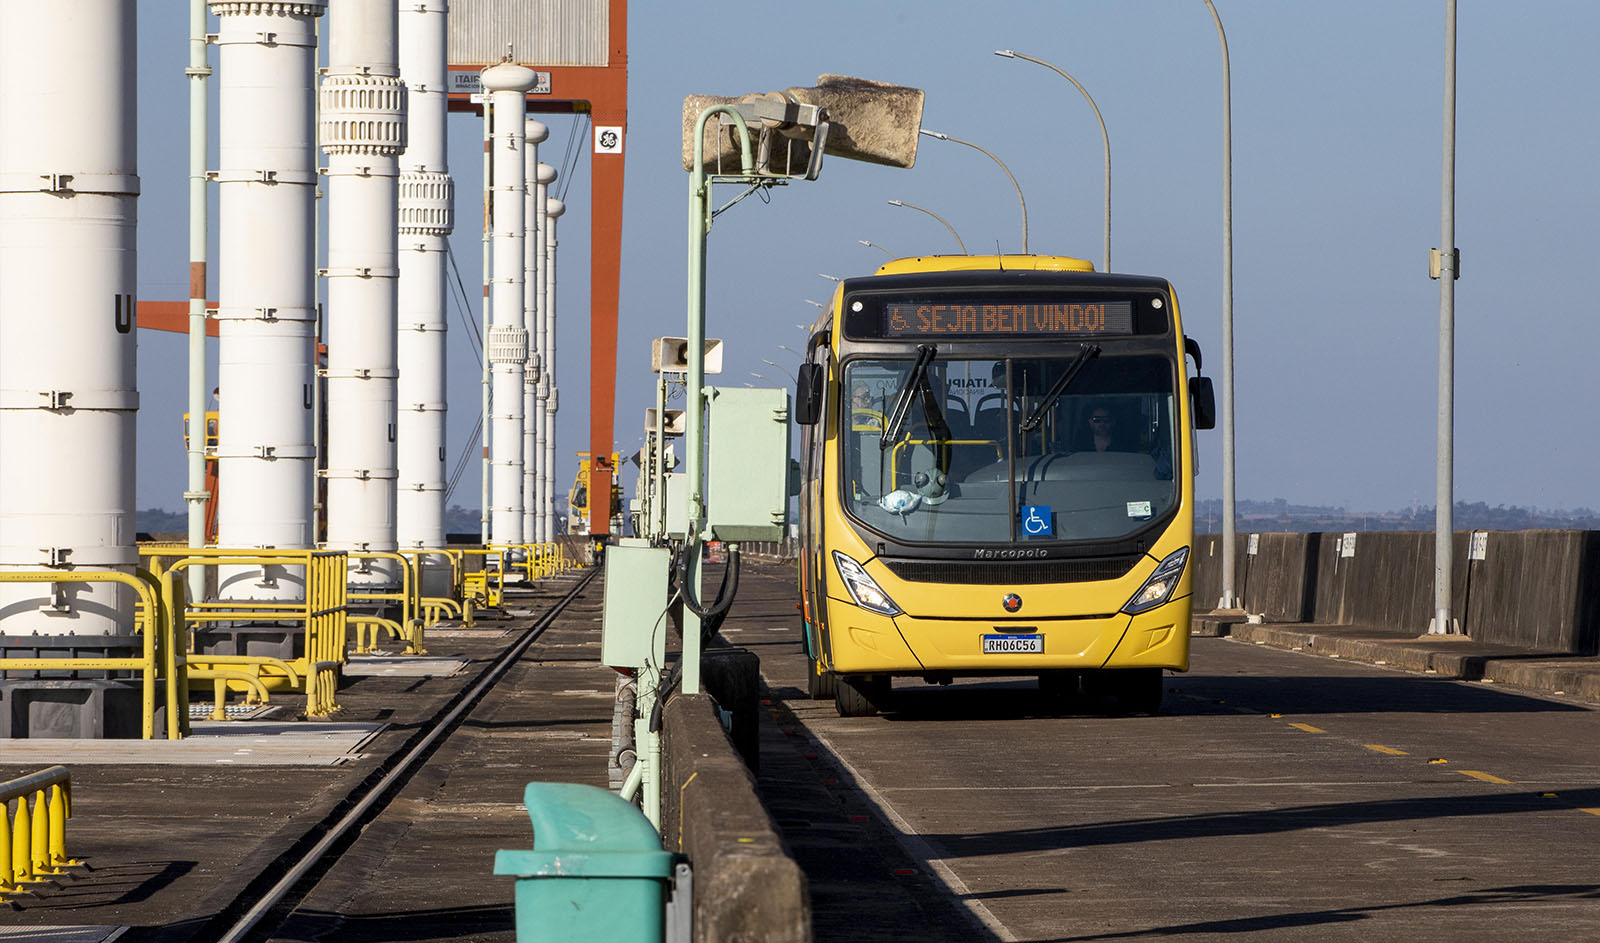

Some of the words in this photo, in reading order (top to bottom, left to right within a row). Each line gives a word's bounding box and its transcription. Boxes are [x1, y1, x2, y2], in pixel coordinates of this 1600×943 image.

[455, 75, 480, 83] ITAIP
[917, 305, 977, 332] SEJA
[983, 305, 1027, 331] BEM
[1034, 304, 1105, 331] VINDO!
[974, 548, 1048, 559] Marcopolo
